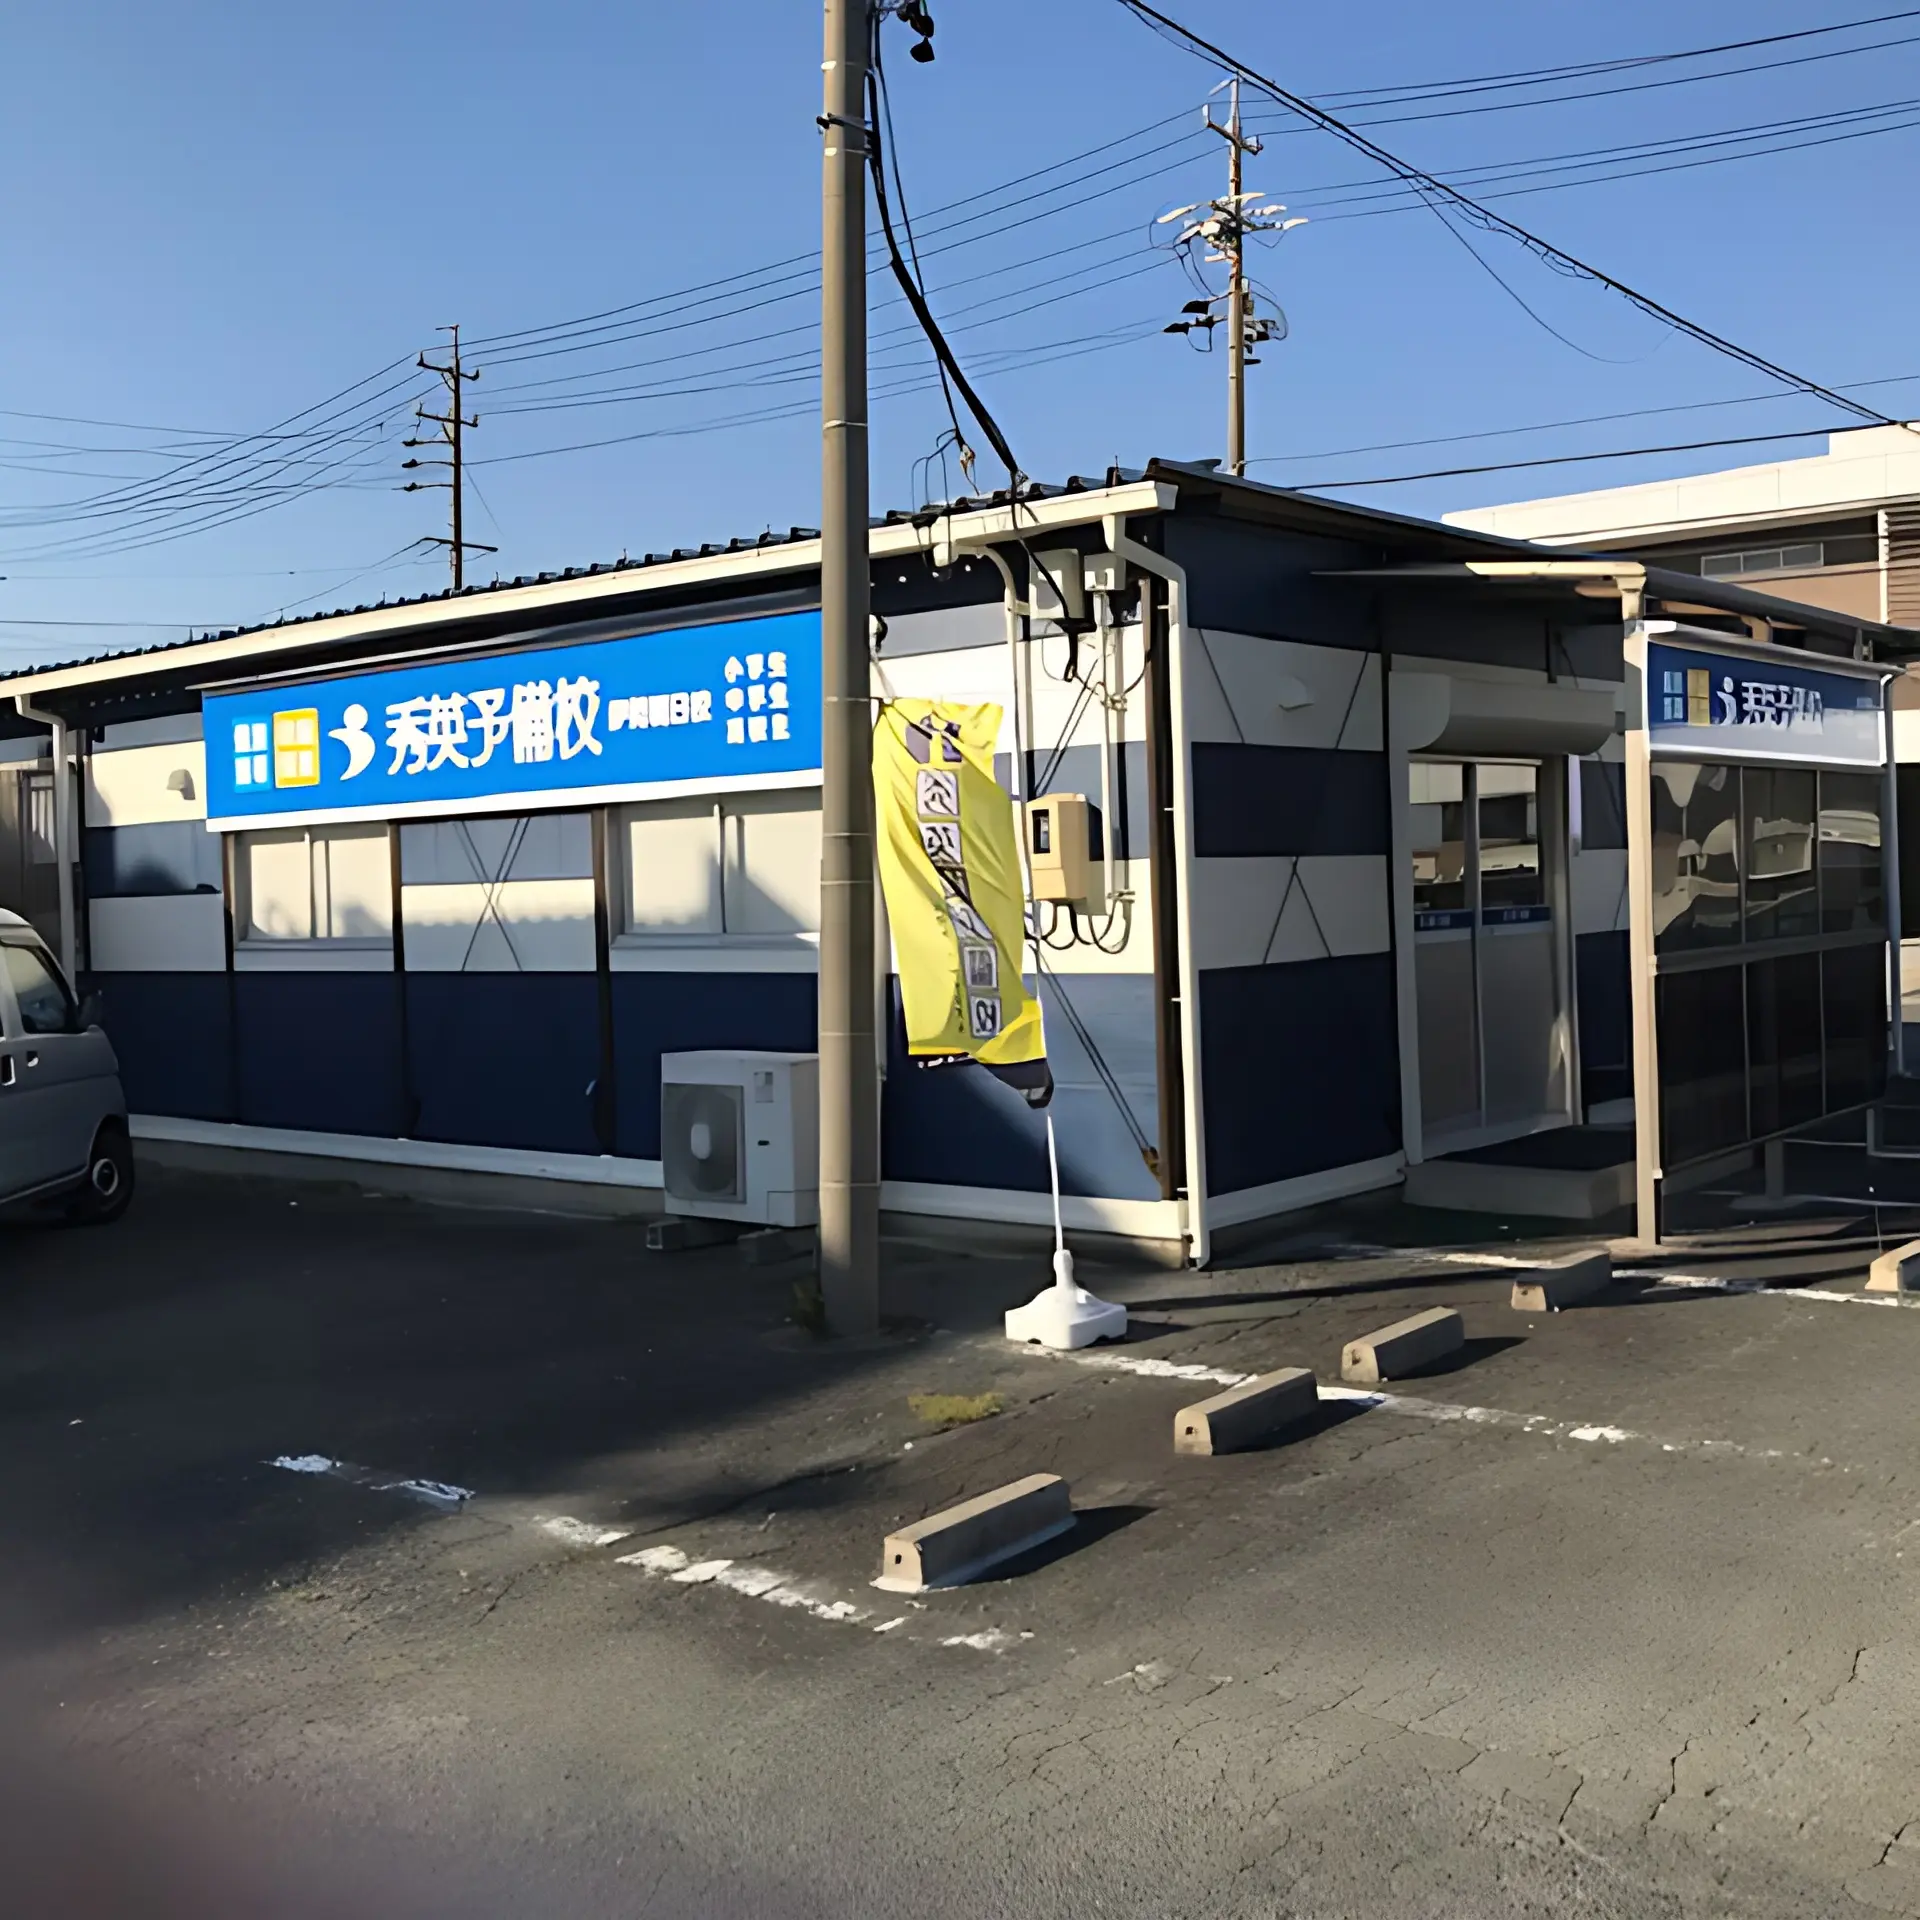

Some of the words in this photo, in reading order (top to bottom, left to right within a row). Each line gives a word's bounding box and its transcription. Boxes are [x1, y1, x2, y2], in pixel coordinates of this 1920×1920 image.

[385, 676, 603, 775] 秀英予備校
